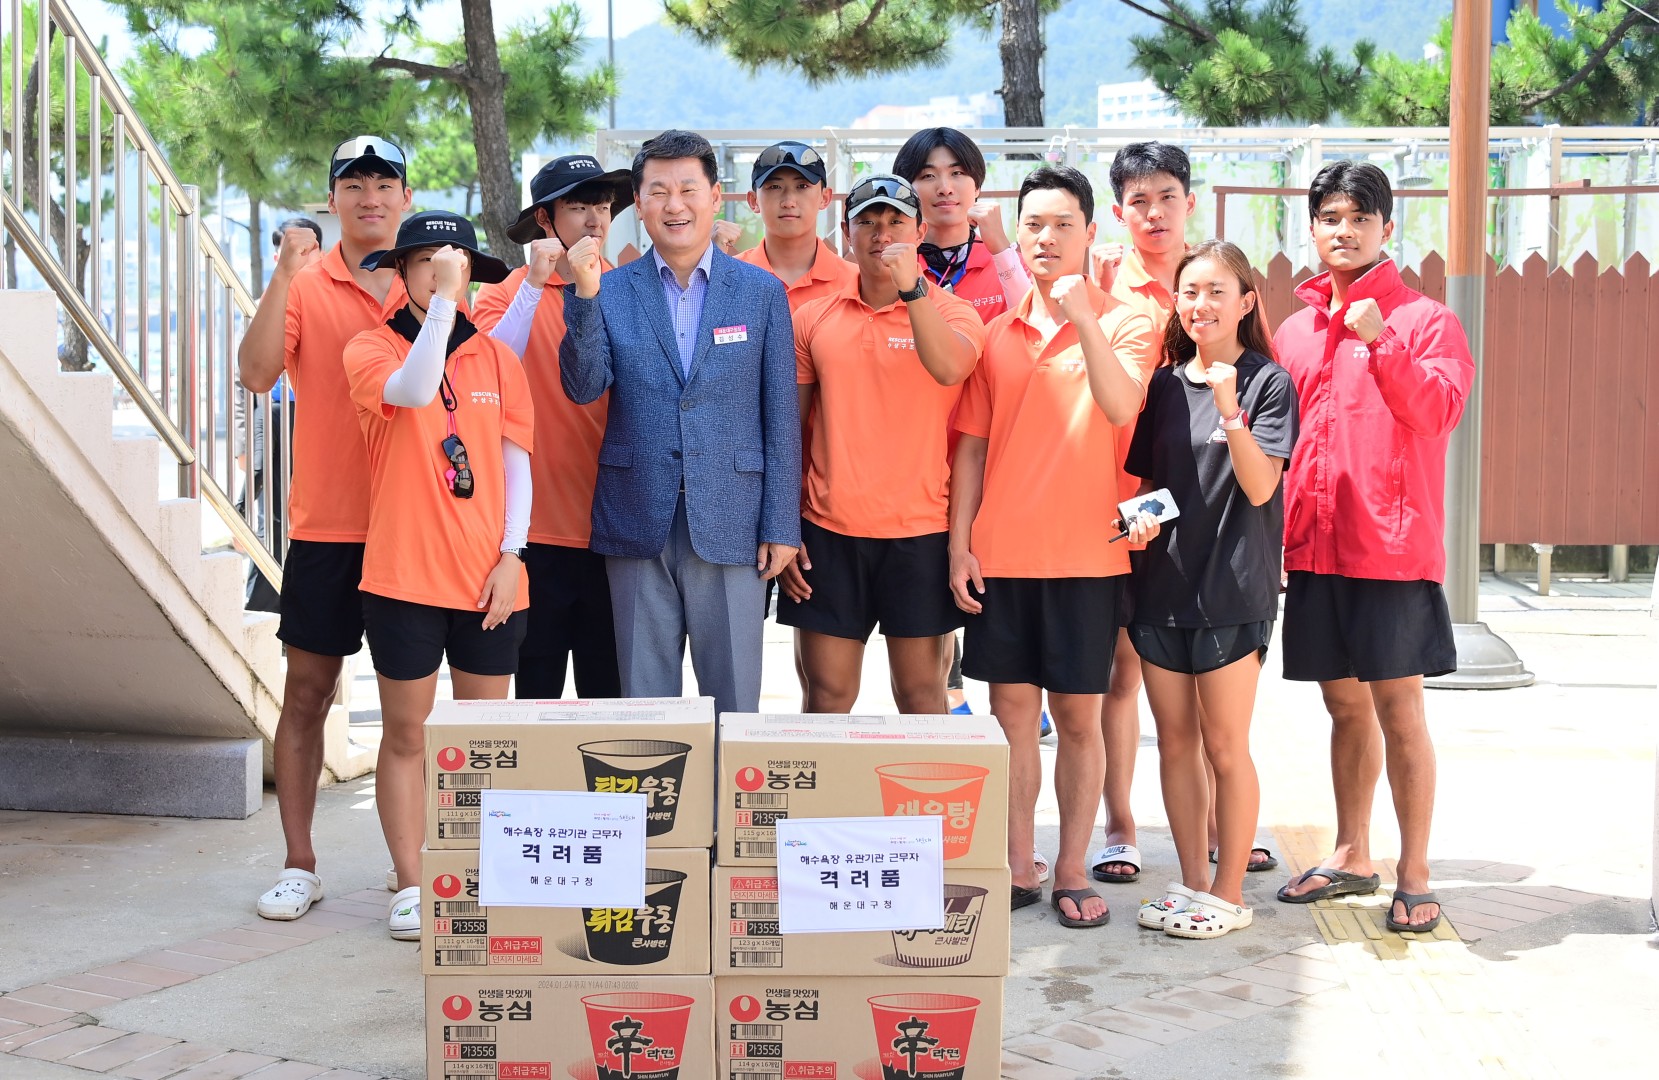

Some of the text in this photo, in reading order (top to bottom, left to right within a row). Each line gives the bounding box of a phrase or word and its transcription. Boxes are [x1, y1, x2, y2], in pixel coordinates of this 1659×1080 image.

[969, 294, 1003, 307] 상구조대
[472, 397, 500, 406] 수상구조
[469, 739, 518, 748] 인생을 맛있게
[468, 749, 517, 769] 농심
[767, 759, 817, 769] 인생을 맛있게
[766, 770, 817, 790] 농심
[457, 793, 481, 805] 가355
[646, 811, 672, 820] 사발면
[503, 826, 623, 840] 해수욕장 유관기관 근무자
[943, 835, 968, 844] 사발면
[1106, 845, 1128, 854] NIKE
[800, 852, 920, 865] 해수욕장 유관기관 근무자
[465, 868, 479, 876] 인생
[734, 891, 755, 900] 던지지
[585, 903, 674, 936] 튀김우동
[453, 920, 486, 933] 가3558
[503, 940, 539, 951] 취급주의
[631, 937, 667, 948] 큰사발면
[934, 936, 969, 945] 큰사발면
[492, 955, 539, 964] 던지지 마세요
[478, 989, 532, 999] 인생을 맛있게
[765, 988, 819, 998] 인생을 맛있게
[478, 1000, 532, 1022] 농심
[765, 999, 818, 1021] 농심
[462, 1045, 495, 1058] 가3556
[646, 1048, 675, 1060] 라면
[748, 1044, 781, 1056] 가3556
[931, 1048, 960, 1061] 라면
[512, 1066, 547, 1076] 취급주의
[798, 1065, 833, 1076] 취급주의
